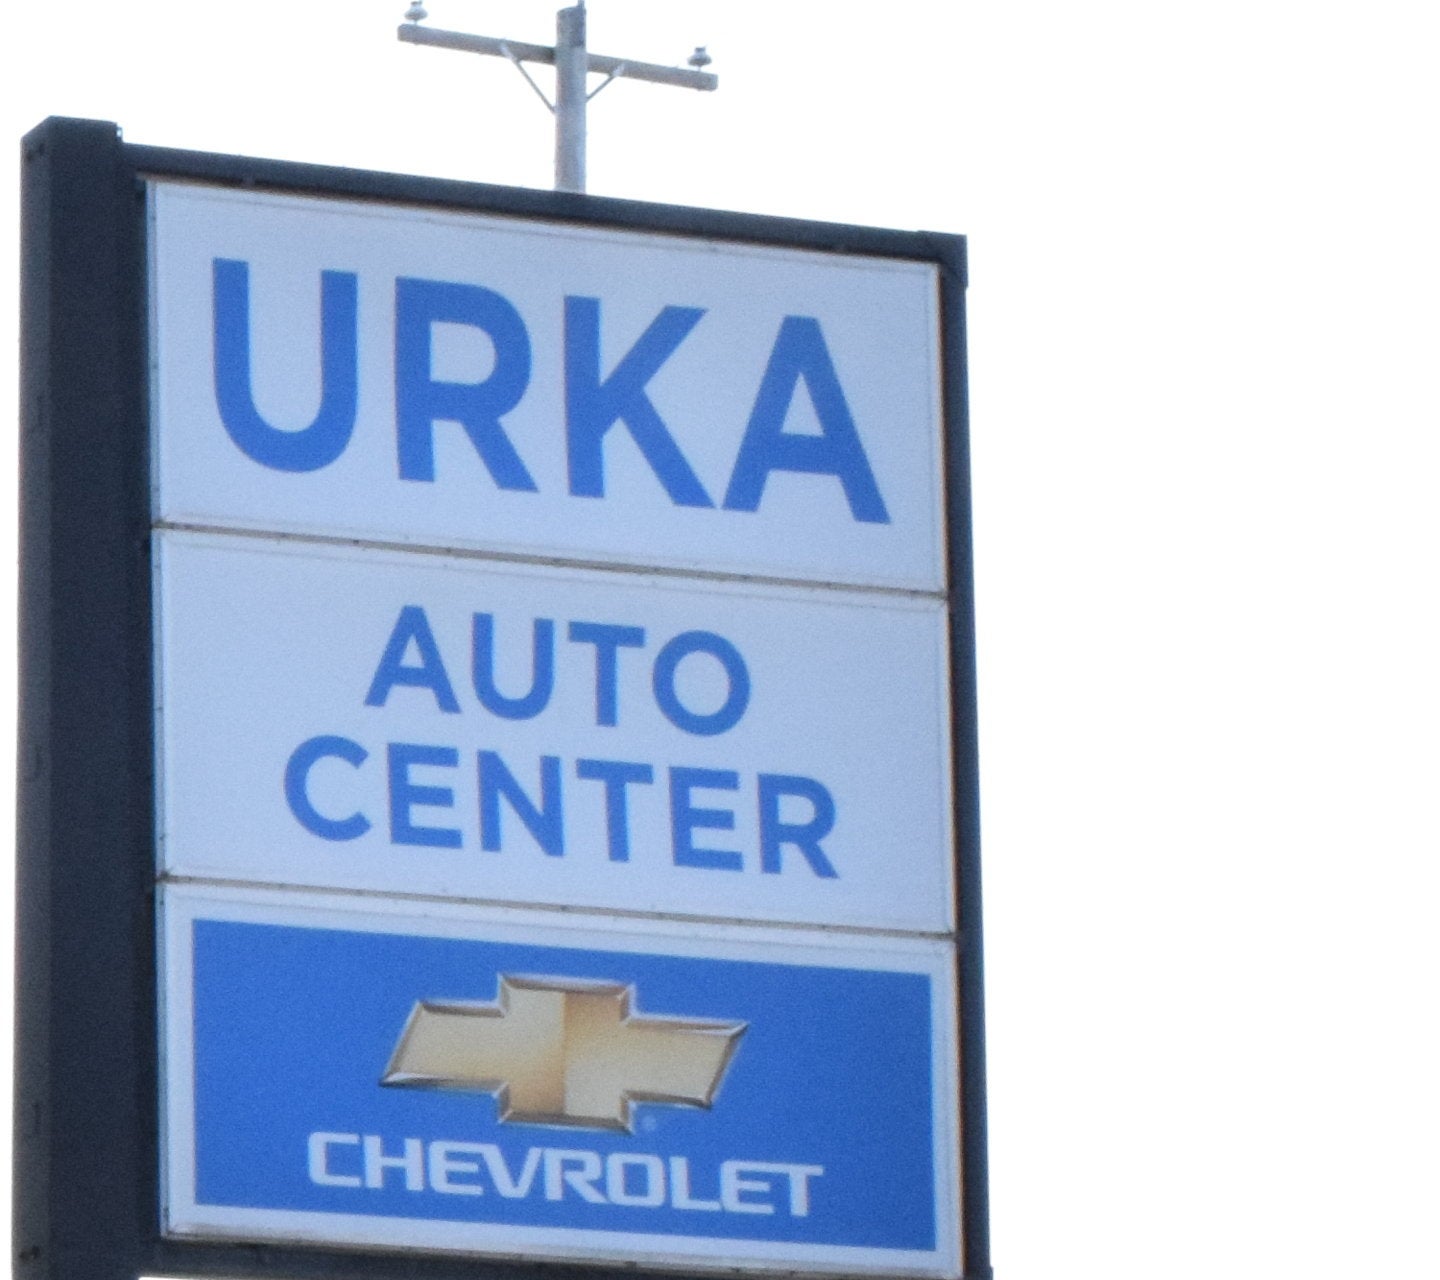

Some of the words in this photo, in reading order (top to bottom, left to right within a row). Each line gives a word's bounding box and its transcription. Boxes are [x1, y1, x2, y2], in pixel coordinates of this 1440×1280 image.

[212, 257, 891, 525] URKA
[363, 604, 750, 736] AUTO
[283, 735, 840, 880] CENTER
[307, 1130, 824, 1217] CHEVROLET
